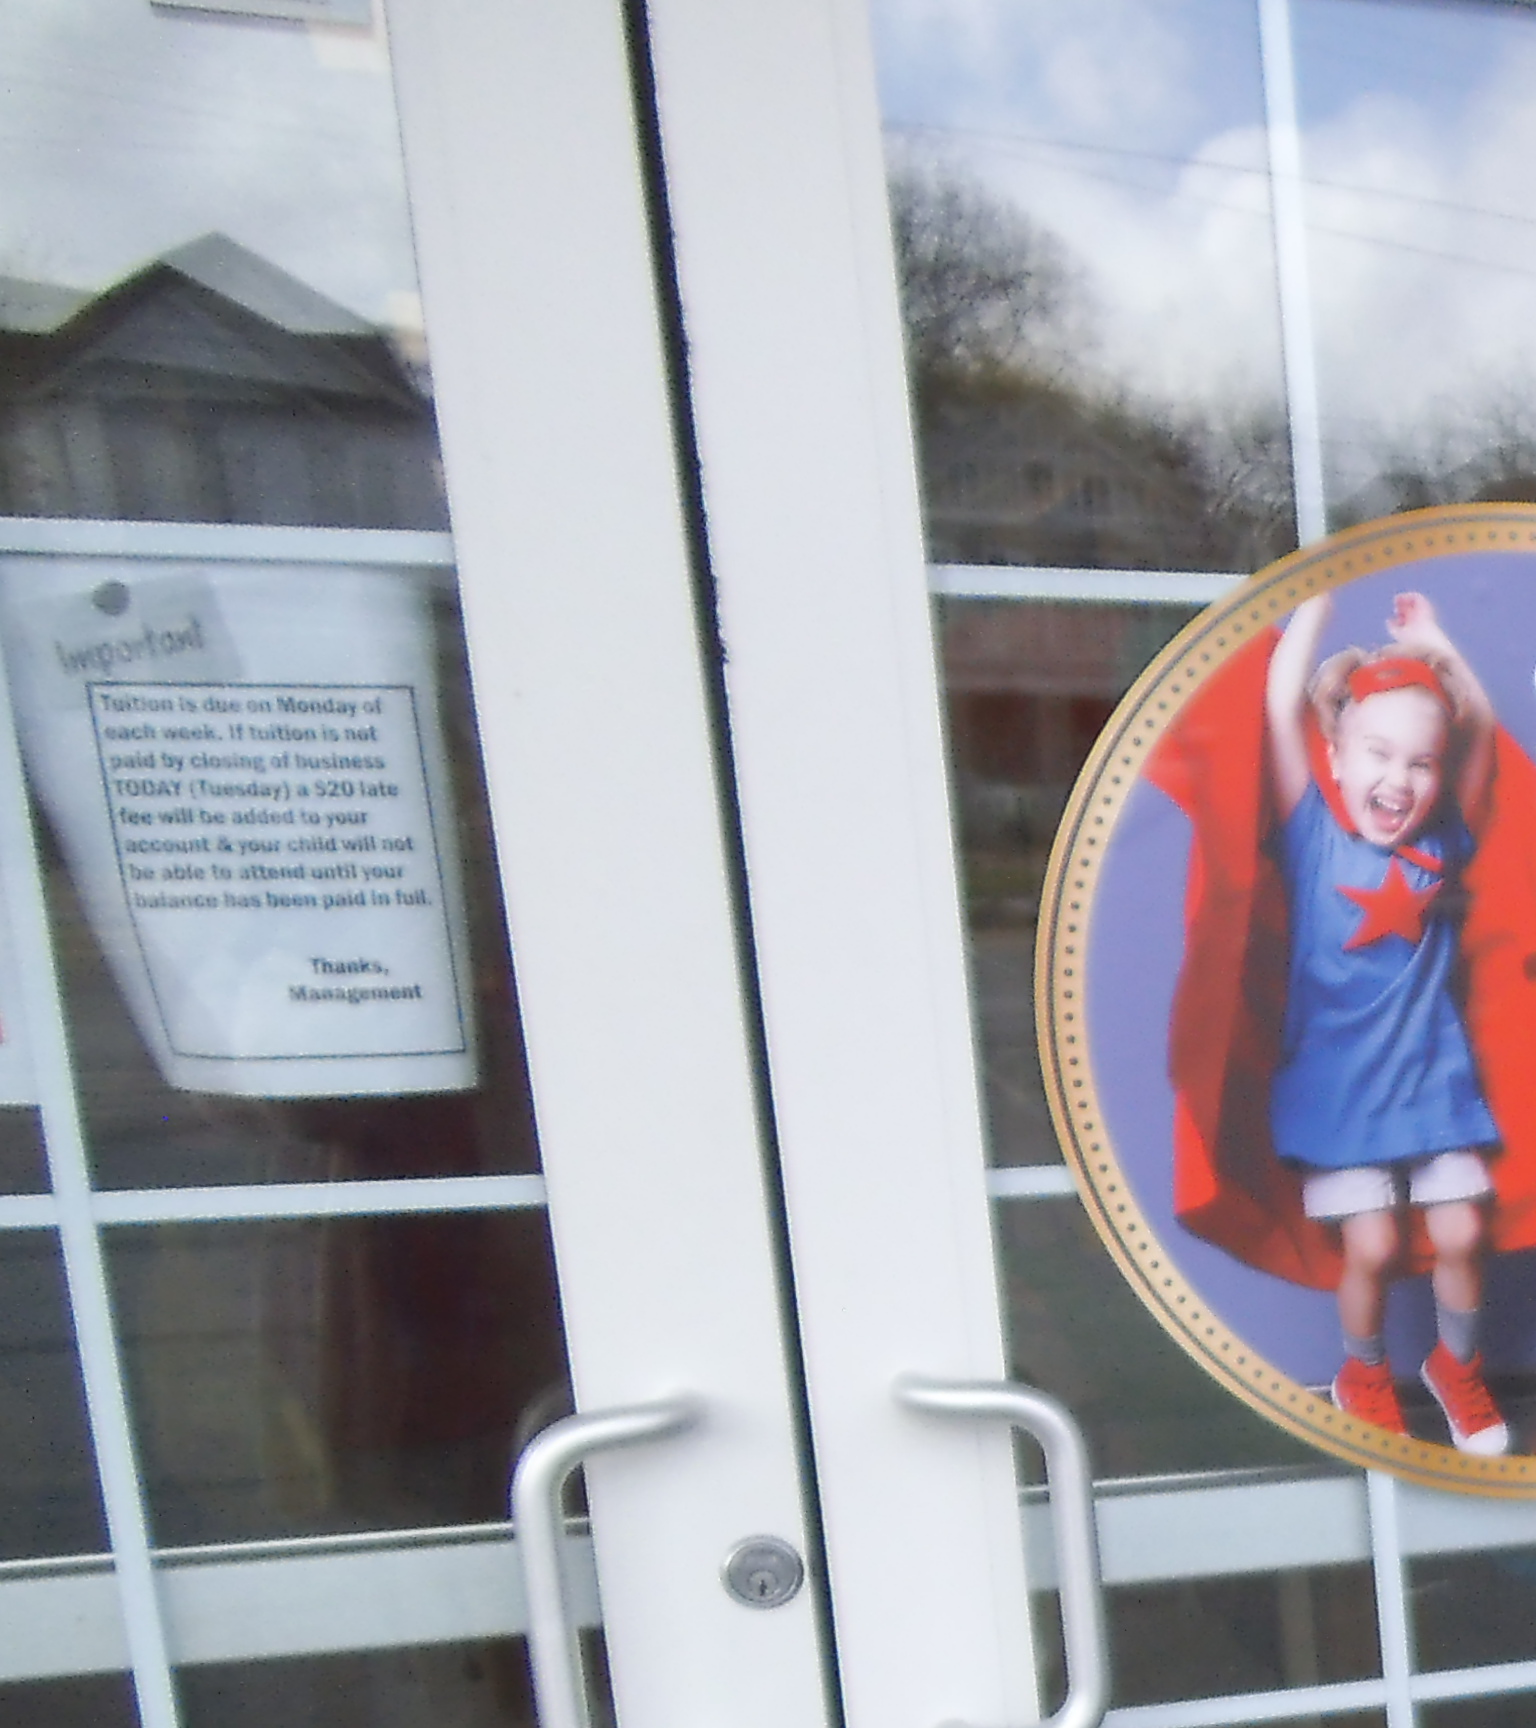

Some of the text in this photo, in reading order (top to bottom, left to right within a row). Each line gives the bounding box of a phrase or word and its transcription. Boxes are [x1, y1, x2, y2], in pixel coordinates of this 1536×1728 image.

[101, 694, 382, 717] Tuition is due on Monday of
[104, 723, 378, 741] each week. If tuition is not
[110, 752, 385, 773] paid by closing of business
[114, 779, 181, 797] TODAY
[190, 779, 290, 801] (Tuesday)
[298, 785, 309, 797] a
[360, 781, 398, 797] late
[119, 807, 368, 828] fee will be added to your
[125, 835, 414, 856] account & your child will not
[129, 864, 403, 882] be able to attend until your
[134, 889, 432, 911] balance has been paid in full.
[310, 957, 389, 975] Thanks,
[288, 984, 424, 1004] Management
